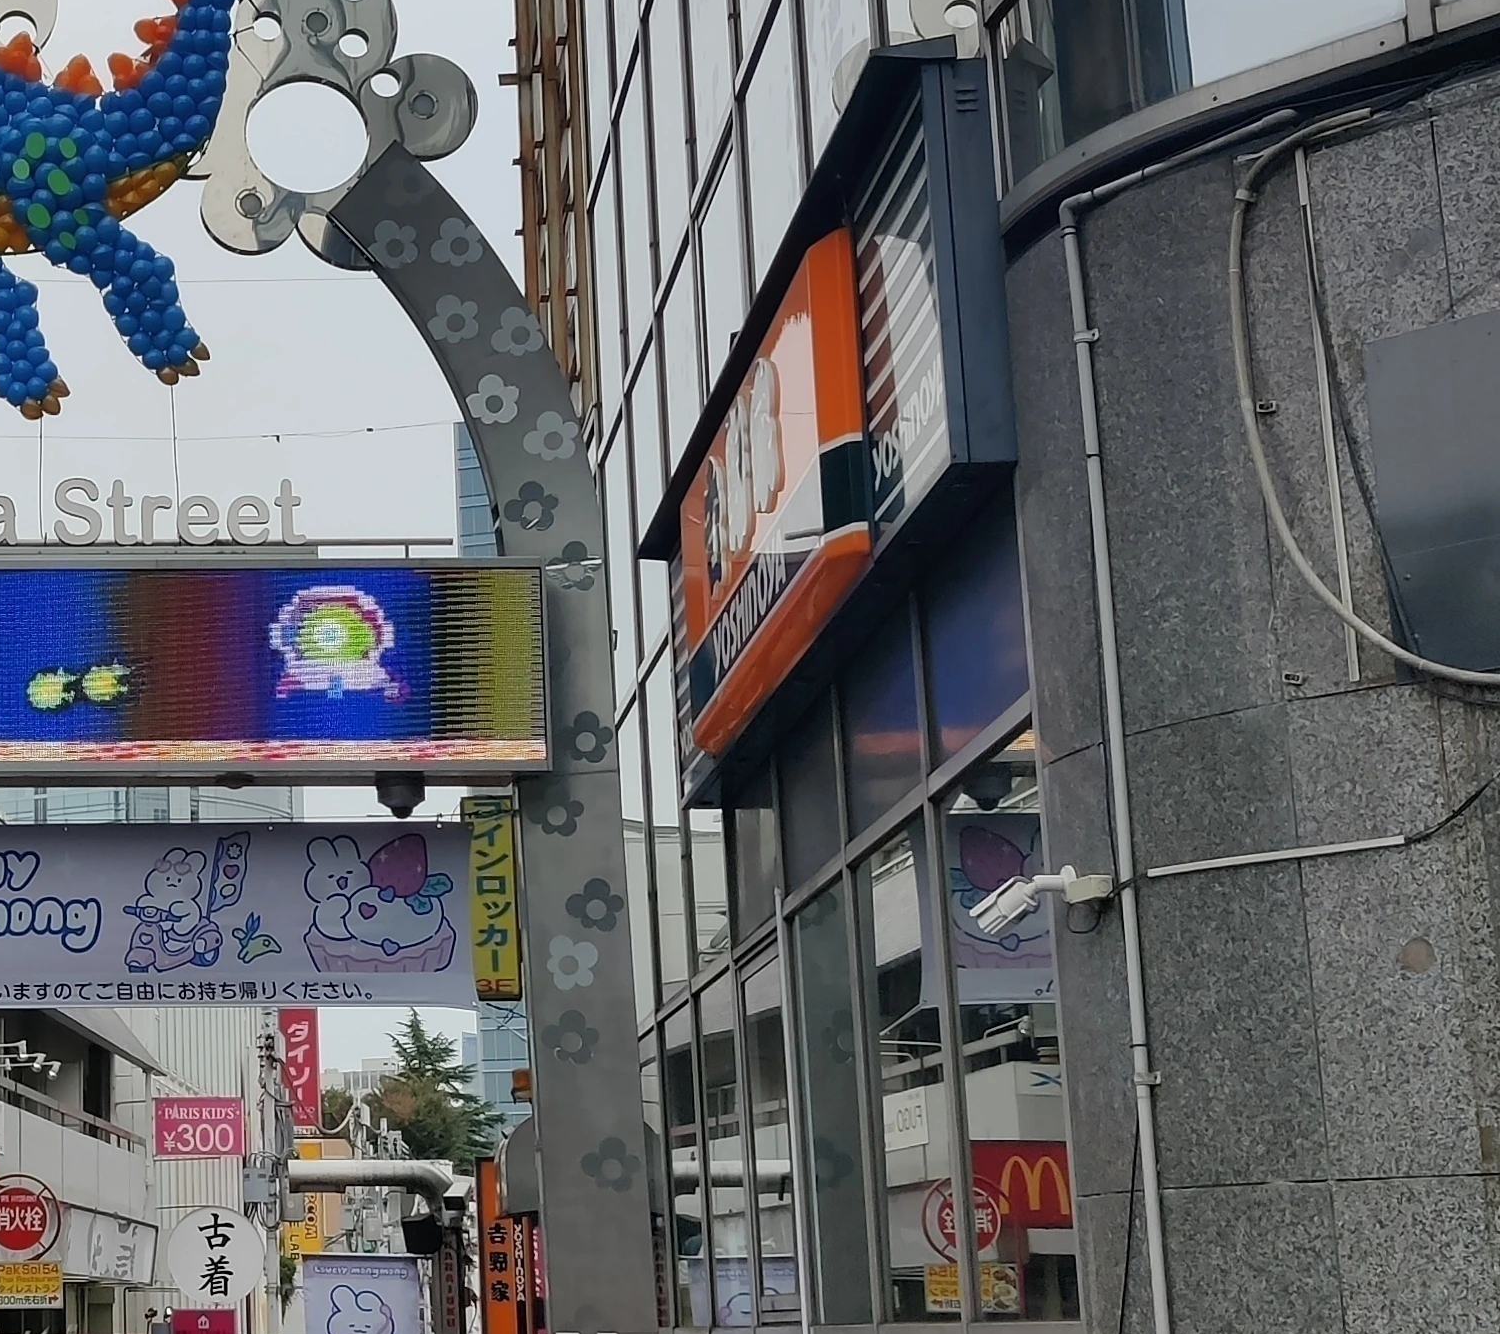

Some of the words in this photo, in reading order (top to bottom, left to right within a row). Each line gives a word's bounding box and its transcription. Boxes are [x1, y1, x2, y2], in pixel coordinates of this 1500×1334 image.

[872, 351, 944, 493] YOSHINOYA
[53, 477, 307, 547] Street
[712, 527, 787, 685] YOSHINOYA
[286, 1020, 312, 1101] ダイソー
[163, 1124, 234, 1153] ¥300
[164, 1102, 199, 1119] PARIS
[202, 1105, 234, 1119] KID'S
[42, 1264, 59, 1275] 54
[197, 1213, 235, 1297] 古着
[513, 1223, 526, 1302] YOSHINOYA
